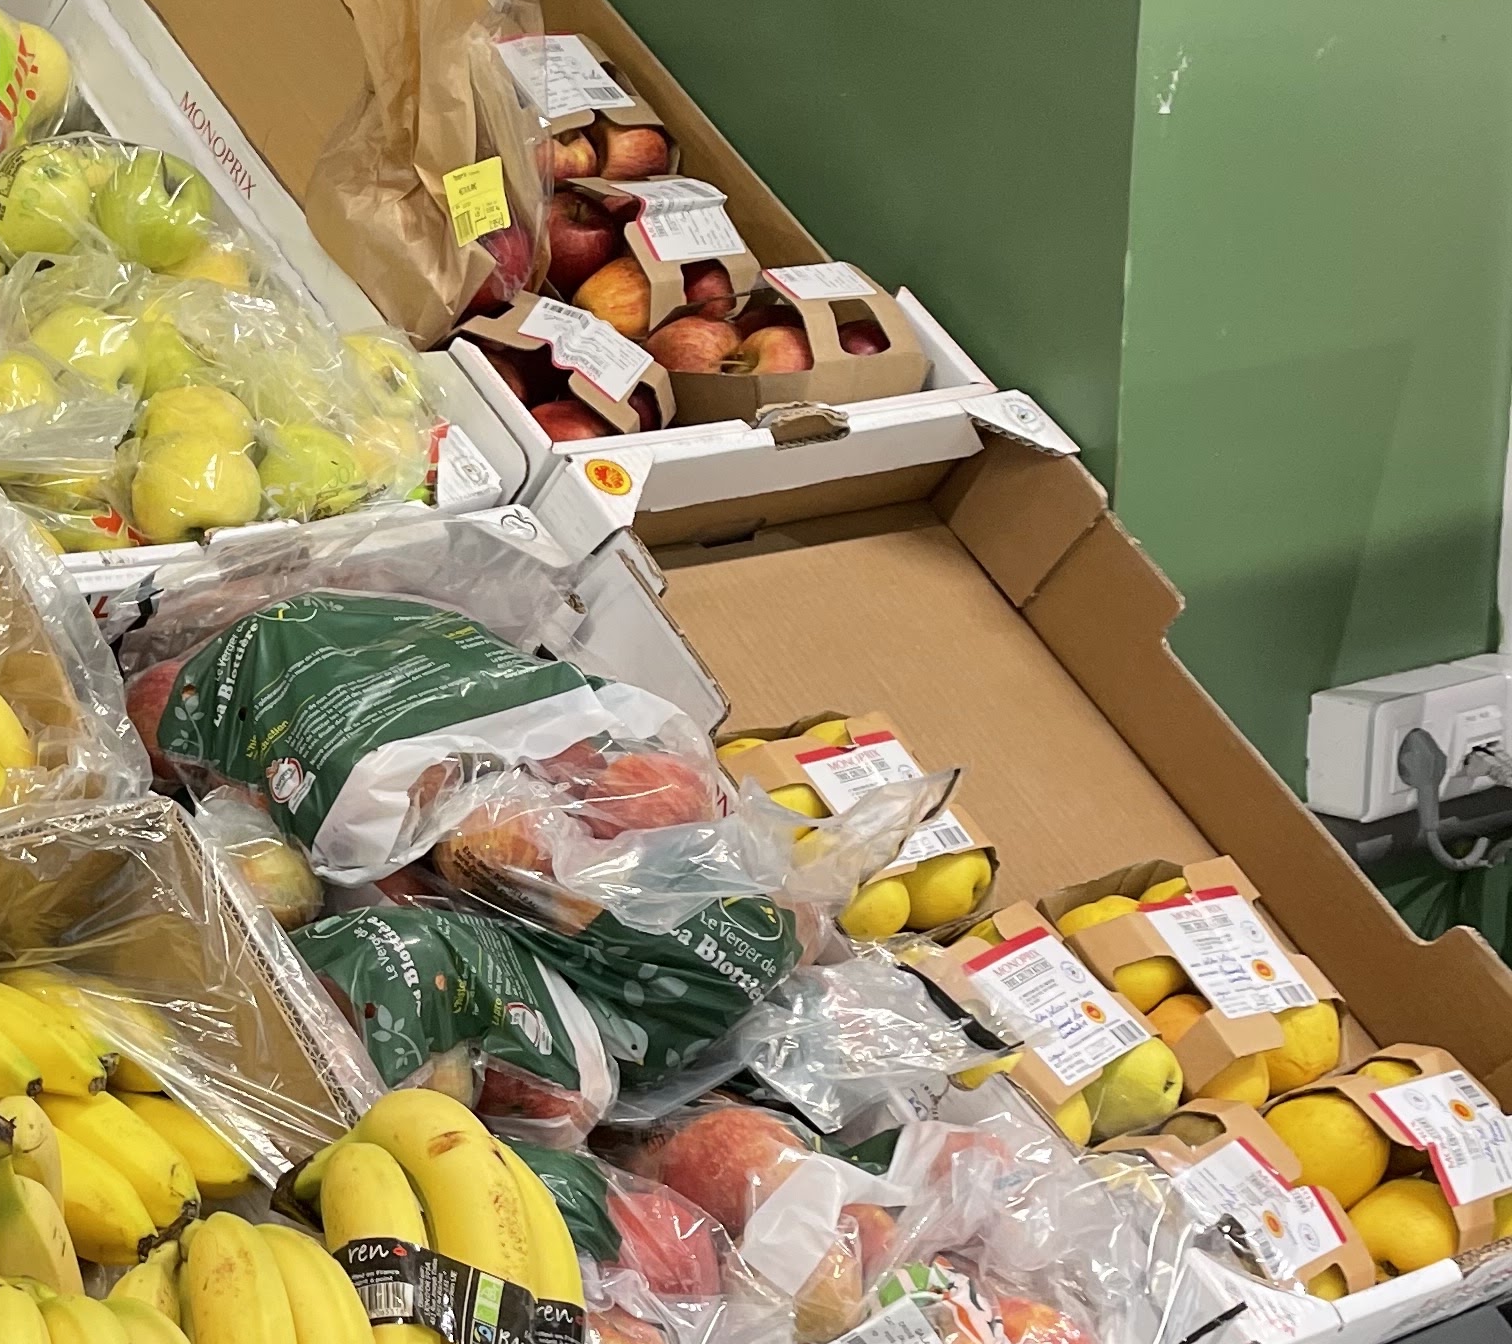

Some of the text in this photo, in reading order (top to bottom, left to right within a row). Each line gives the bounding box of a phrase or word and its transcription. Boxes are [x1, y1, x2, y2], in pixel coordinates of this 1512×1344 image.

[180, 90, 257, 201] MONOPRIX
[699, 910, 777, 978] Le Verger de
[347, 1243, 390, 1264] ren
